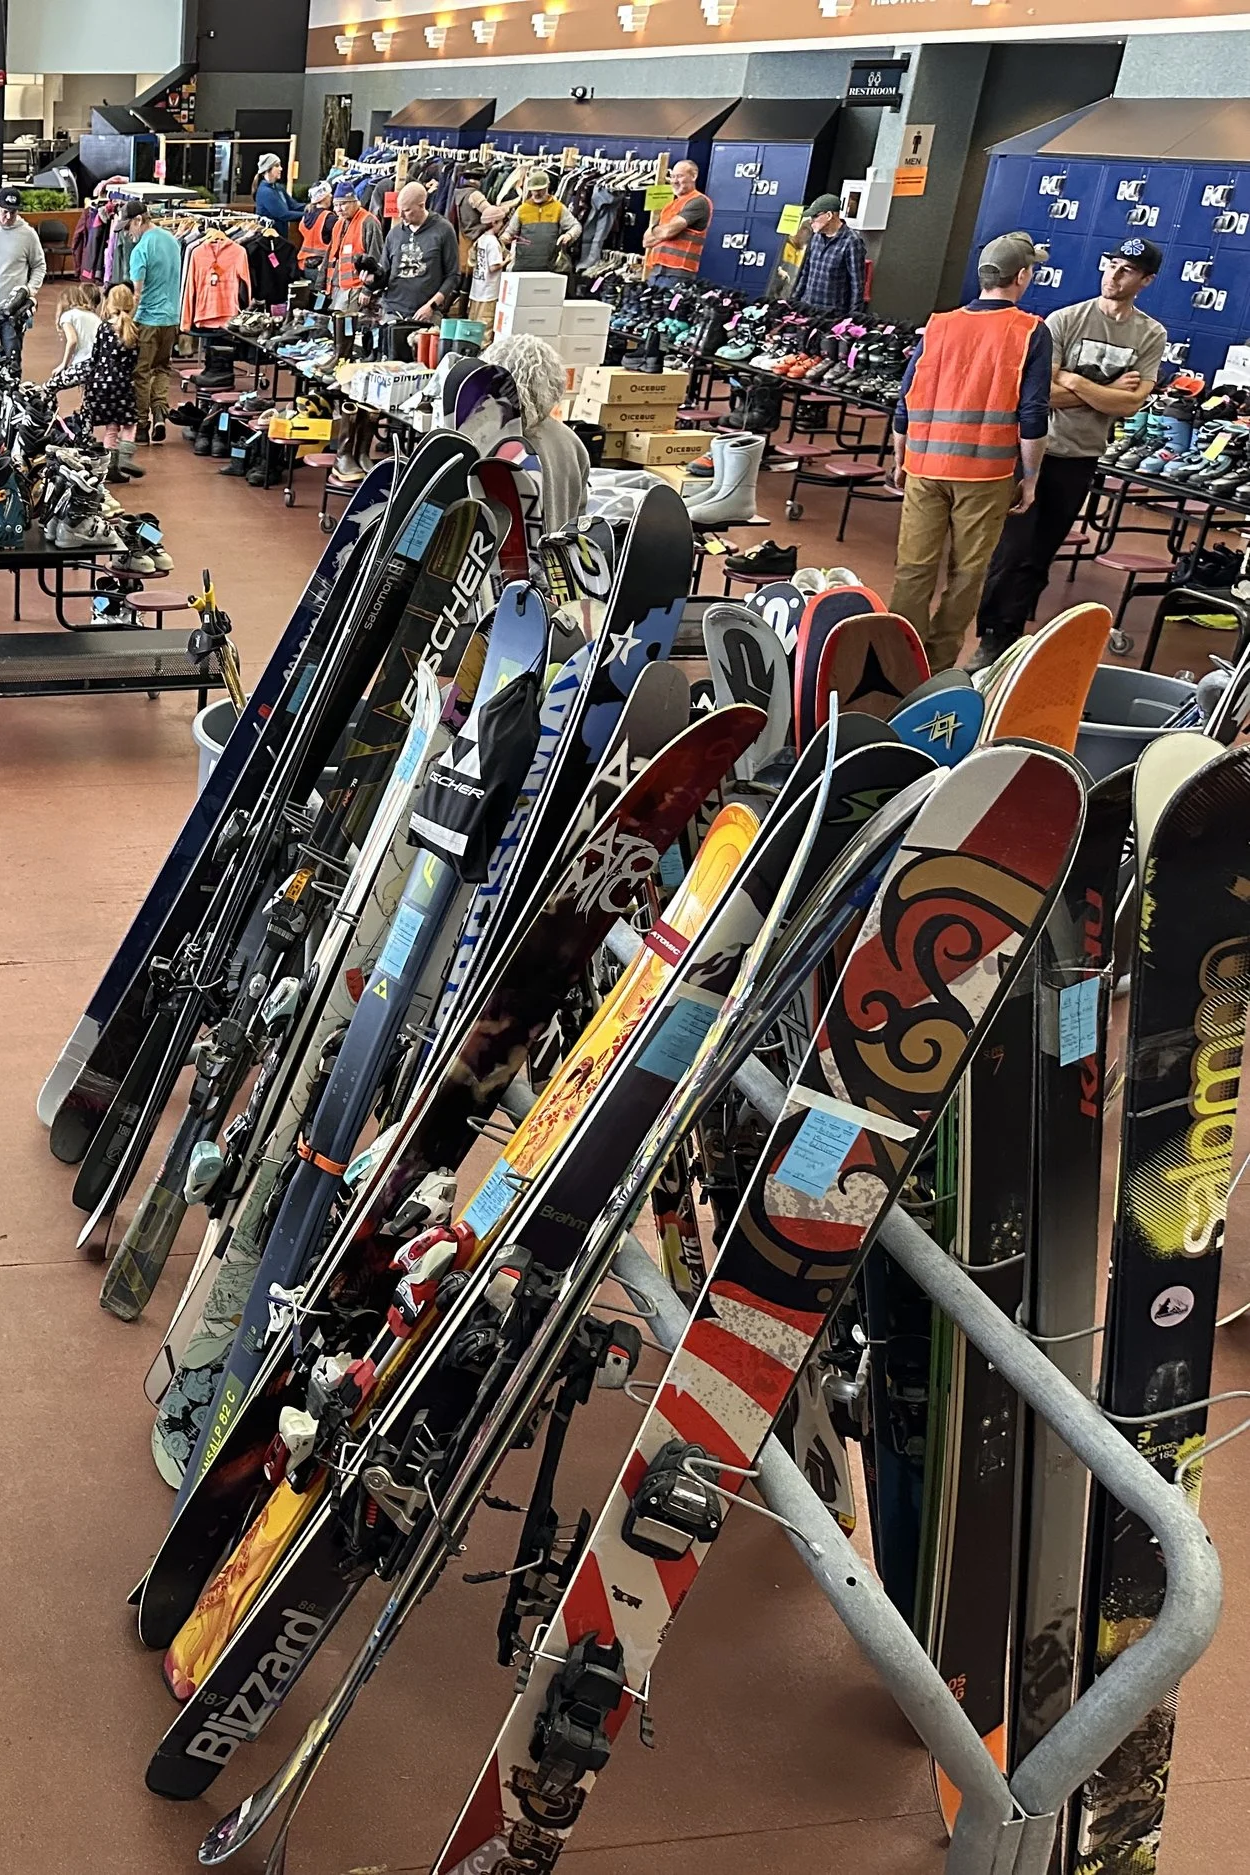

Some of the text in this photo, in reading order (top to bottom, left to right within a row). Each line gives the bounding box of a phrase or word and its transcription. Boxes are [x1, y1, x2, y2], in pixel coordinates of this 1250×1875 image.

[848, 86, 896, 96] RESTROOM
[904, 157, 922, 166] MEN
[637, 384, 667, 392] ICEBUG
[627, 413, 656, 421] ICEBUG
[673, 446, 702, 454] ICEBUG
[363, 575, 397, 630] salomon
[650, 930, 684, 956] ATOMIC
[1164, 936, 1250, 1258] salomon
[199, 1389, 237, 1480] ANSALP 82 C
[184, 1608, 323, 1766] Blizzard
